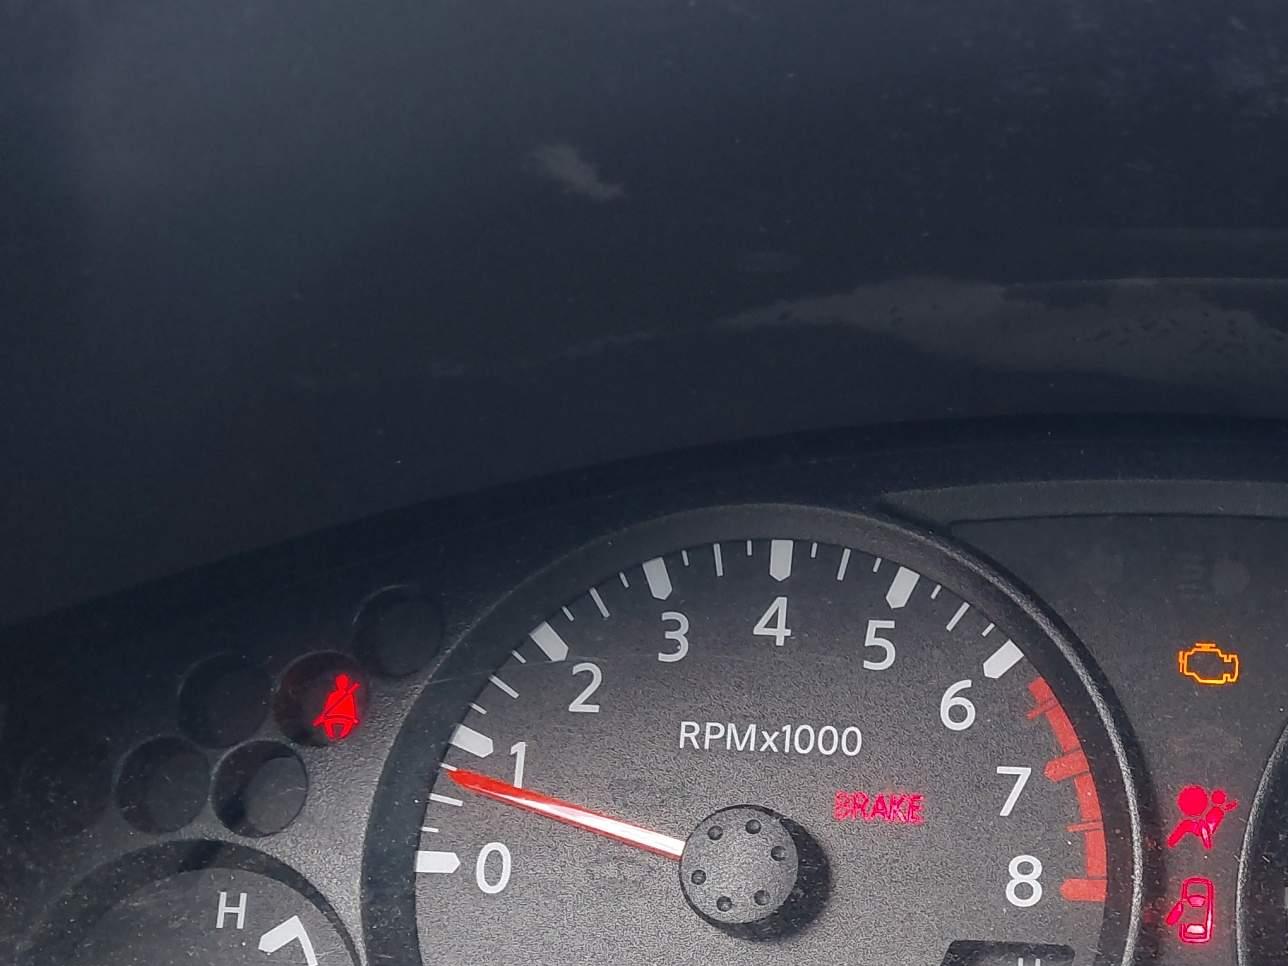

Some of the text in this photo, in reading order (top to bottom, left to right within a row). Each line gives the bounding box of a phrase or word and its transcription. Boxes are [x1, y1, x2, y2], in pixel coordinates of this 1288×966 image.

[658, 612, 688, 662] 3
[753, 597, 791, 646] 4
[864, 620, 895, 670] 5
[568, 663, 602, 713] 2
[941, 680, 975, 730] 6
[680, 722, 861, 756] RPMx1000
[510, 742, 526, 789] 1
[834, 790, 924, 825] BRAKE
[997, 767, 1031, 816] 7
[476, 842, 511, 893] 0
[1006, 855, 1042, 907] 8
[216, 892, 247, 929] H
